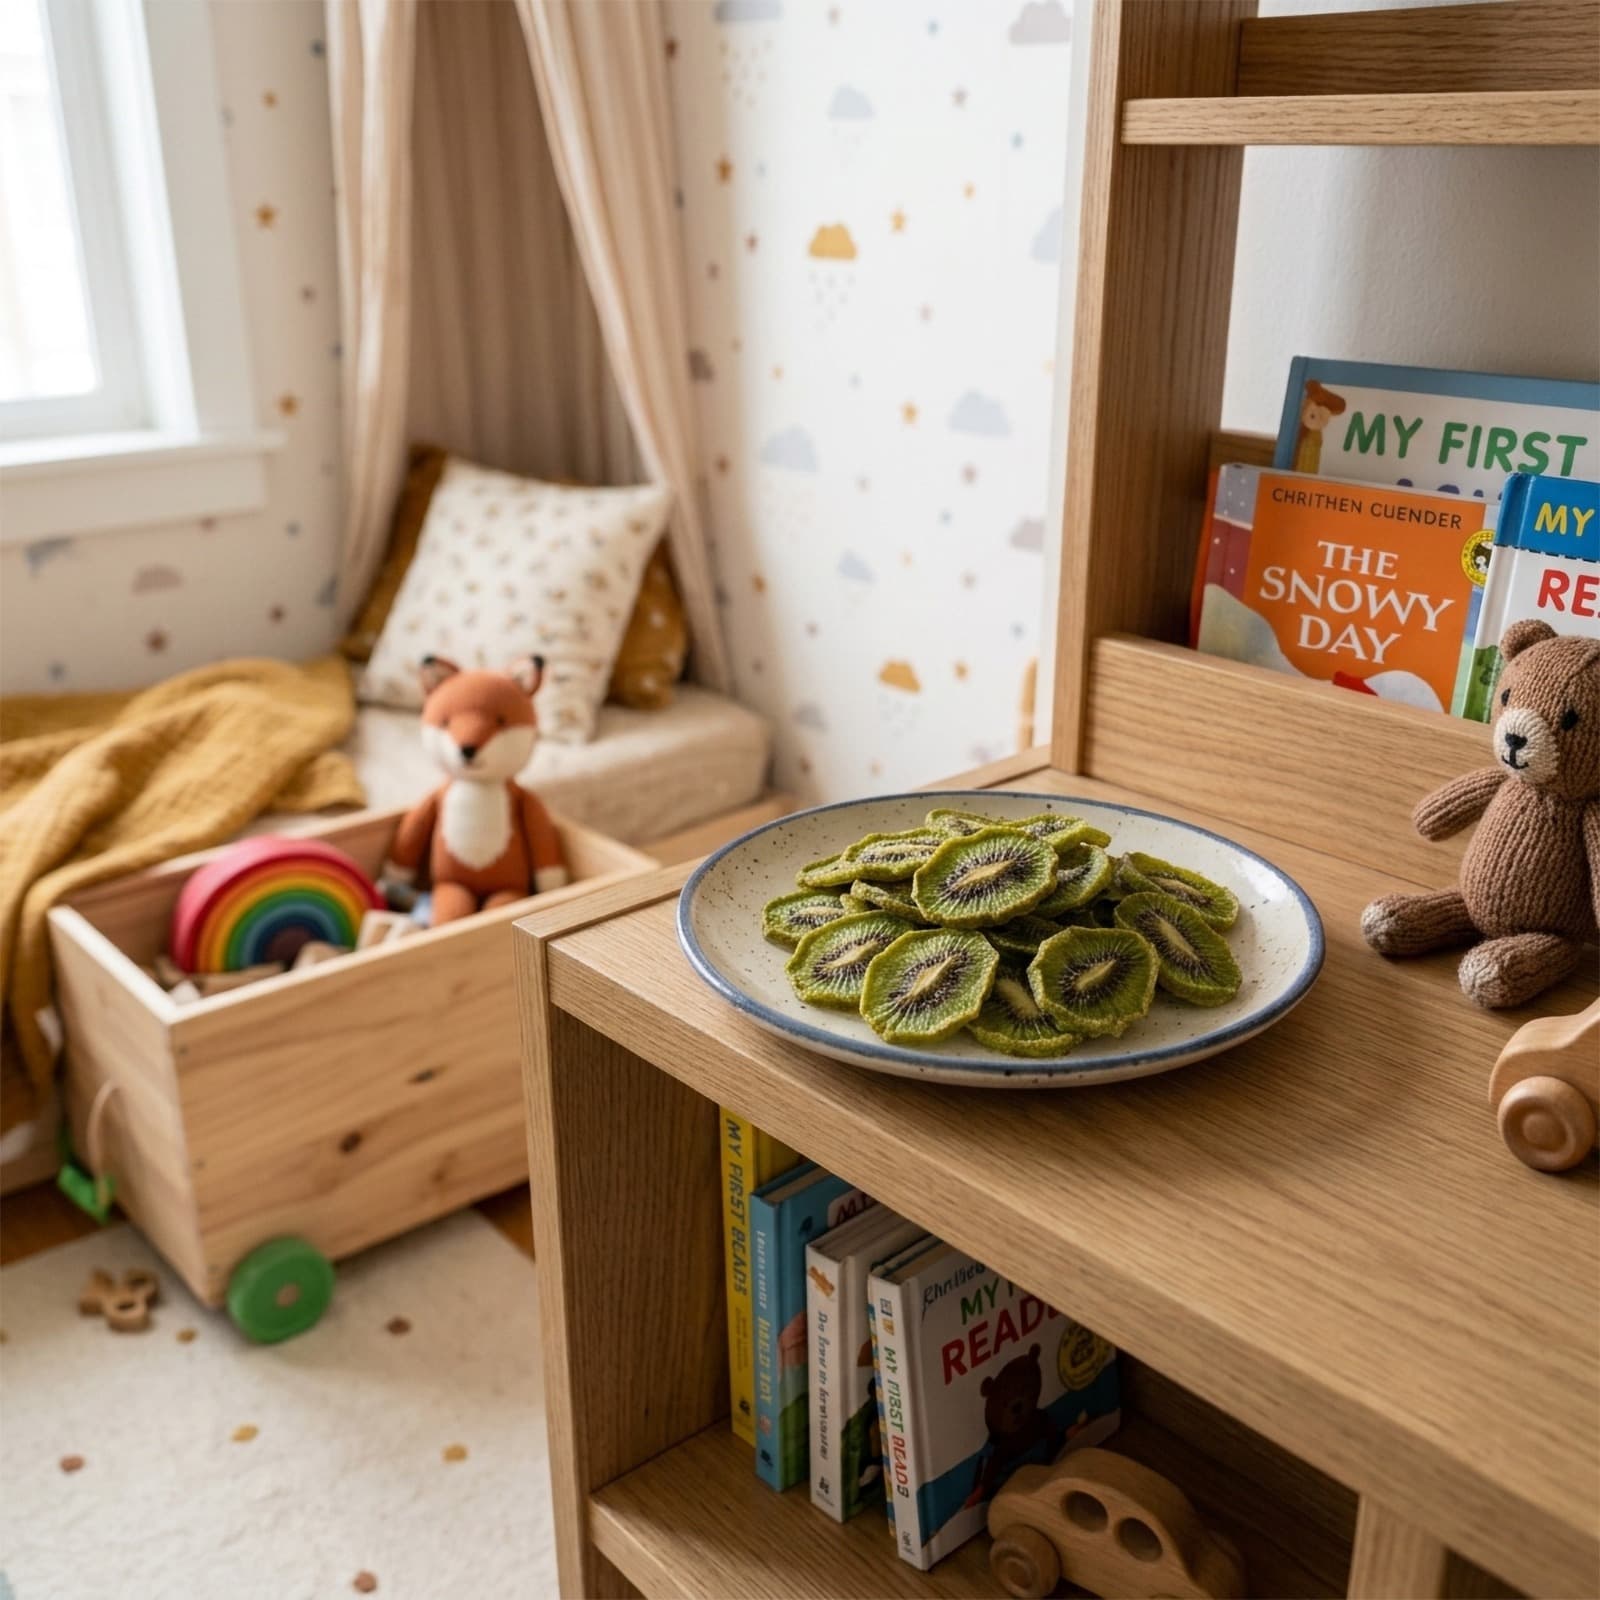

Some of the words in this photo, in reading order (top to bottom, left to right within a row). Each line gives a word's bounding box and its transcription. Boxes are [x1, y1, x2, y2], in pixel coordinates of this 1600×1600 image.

[1342, 411, 1423, 458] MY
[1438, 422, 1588, 477] FIRST
[1271, 487, 1363, 514] CHRITHEN
[1370, 502, 1463, 530] CUENDER
[1534, 502, 1595, 537] MY
[1317, 540, 1399, 580] THE
[1259, 566, 1456, 632] SNOWY
[1537, 569, 1600, 618] RE
[1297, 614, 1401, 664] DAY
[726, 1119, 743, 1158] MY
[960, 1277, 999, 1325] MY
